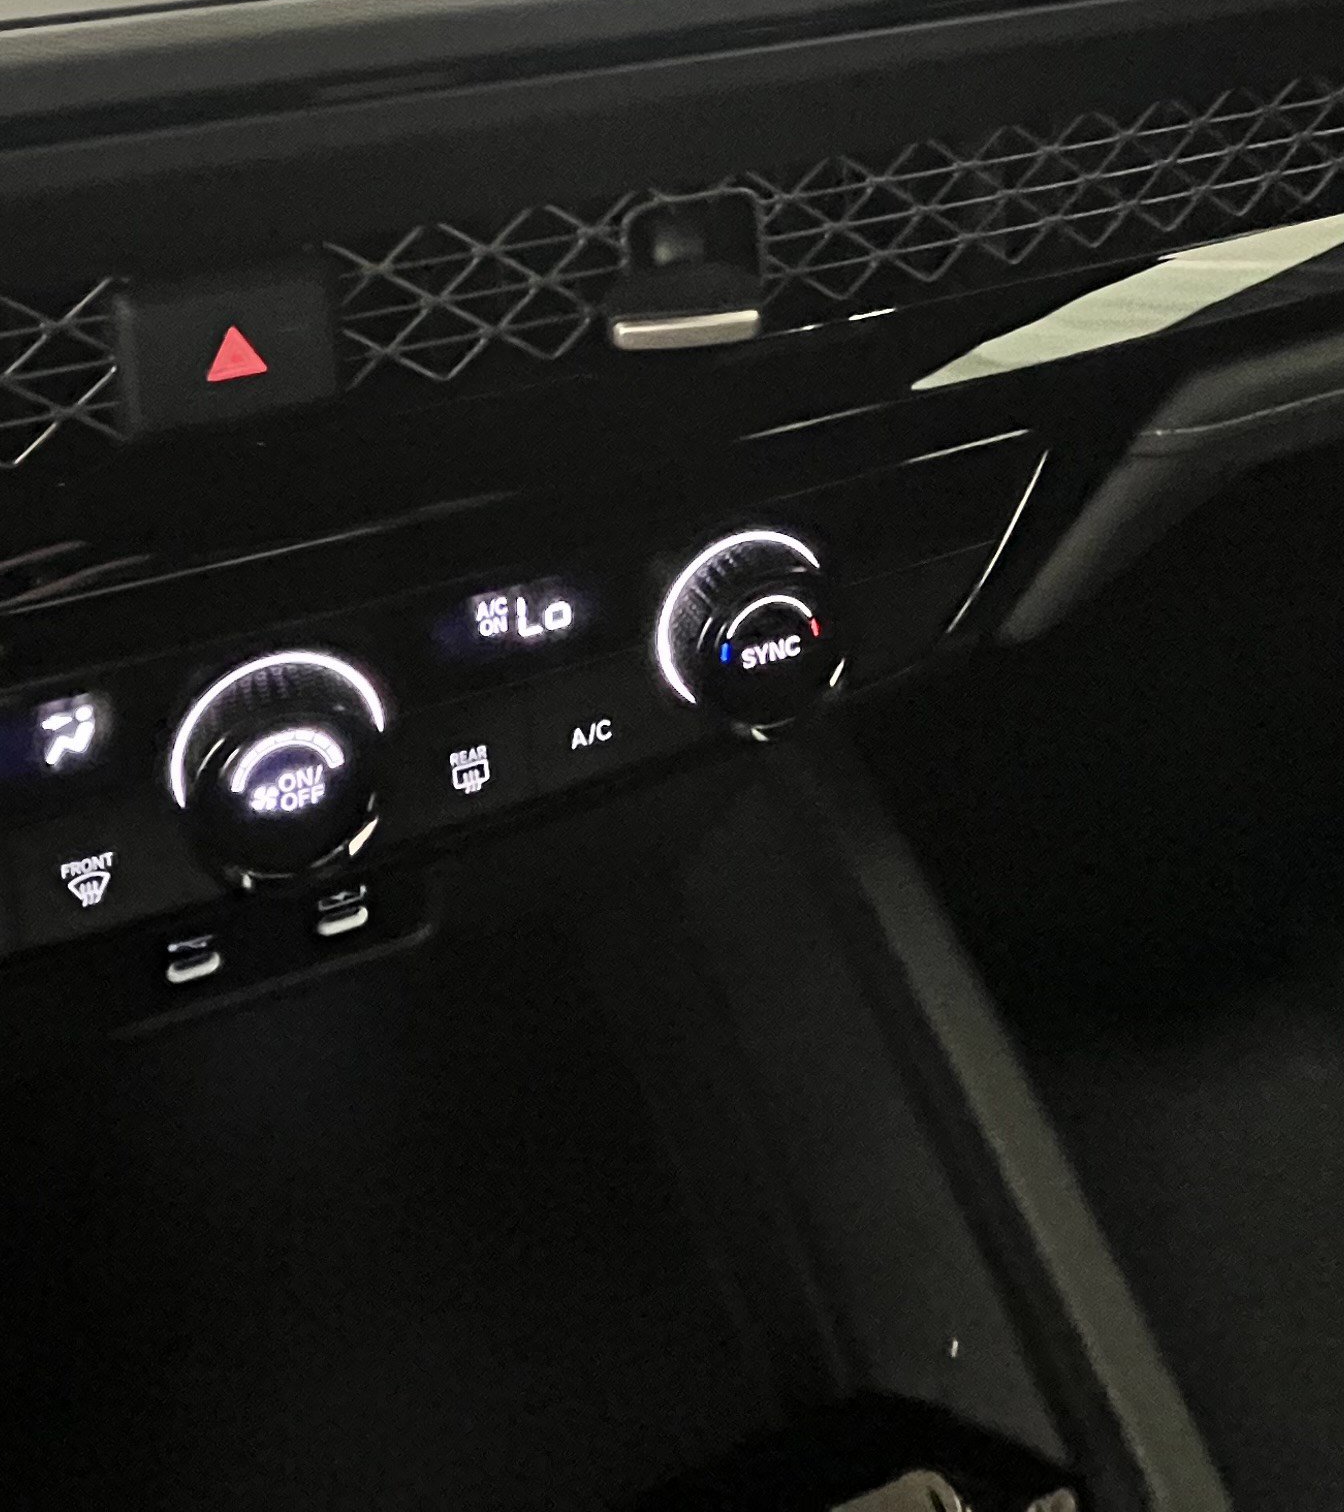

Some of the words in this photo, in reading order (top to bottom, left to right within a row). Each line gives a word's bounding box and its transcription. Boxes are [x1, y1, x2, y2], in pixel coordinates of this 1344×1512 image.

[475, 596, 509, 621] A/C
[515, 596, 572, 639] Lo
[477, 617, 509, 638] ON
[740, 634, 801, 670] SYNC
[571, 719, 613, 750] A/C
[449, 745, 488, 767] REAR
[277, 764, 324, 790] ON/
[280, 784, 326, 811] OFF
[60, 851, 114, 878] FRONT
